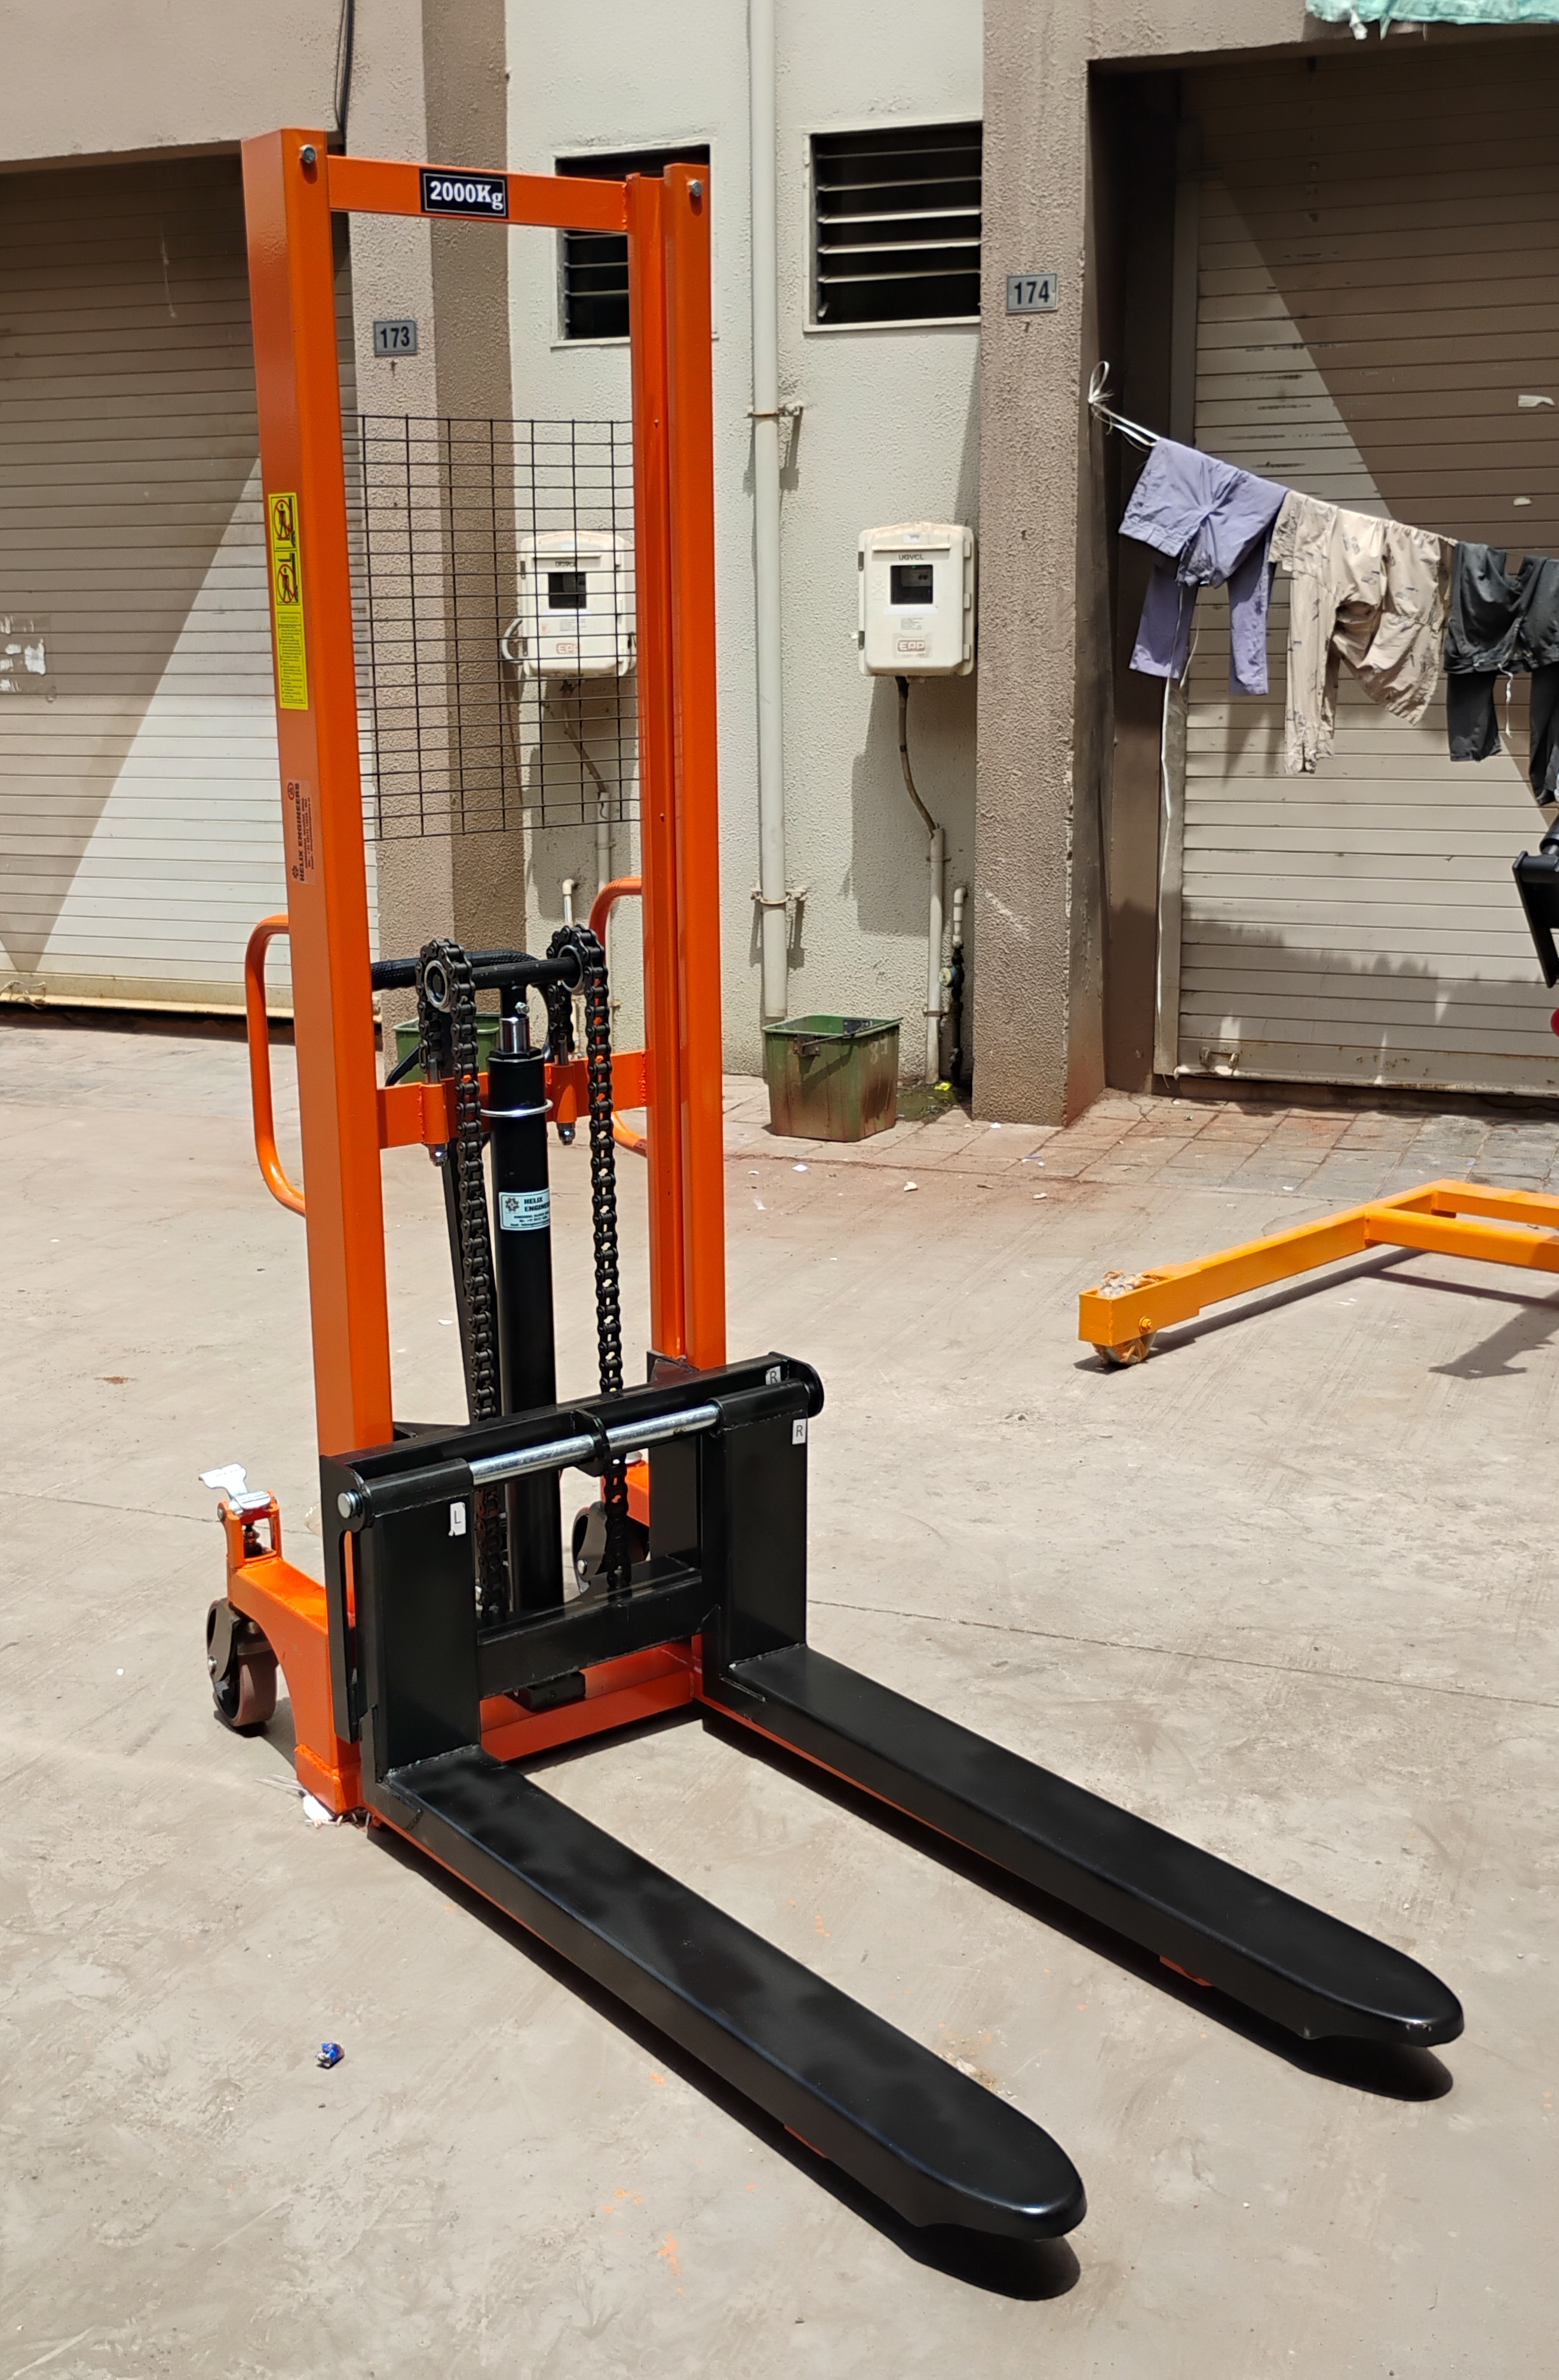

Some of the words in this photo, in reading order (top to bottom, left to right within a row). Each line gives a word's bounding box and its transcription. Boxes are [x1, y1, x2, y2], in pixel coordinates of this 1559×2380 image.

[429, 180, 504, 211] 2000Kg
[1014, 280, 1050, 304] 174
[380, 326, 410, 348] 173
[294, 783, 303, 847] ENGINEERS
[524, 1196, 543, 1205] HELIX
[770, 1370, 778, 1384] R
[796, 1424, 803, 1438] R
[454, 1510, 462, 1524] L
